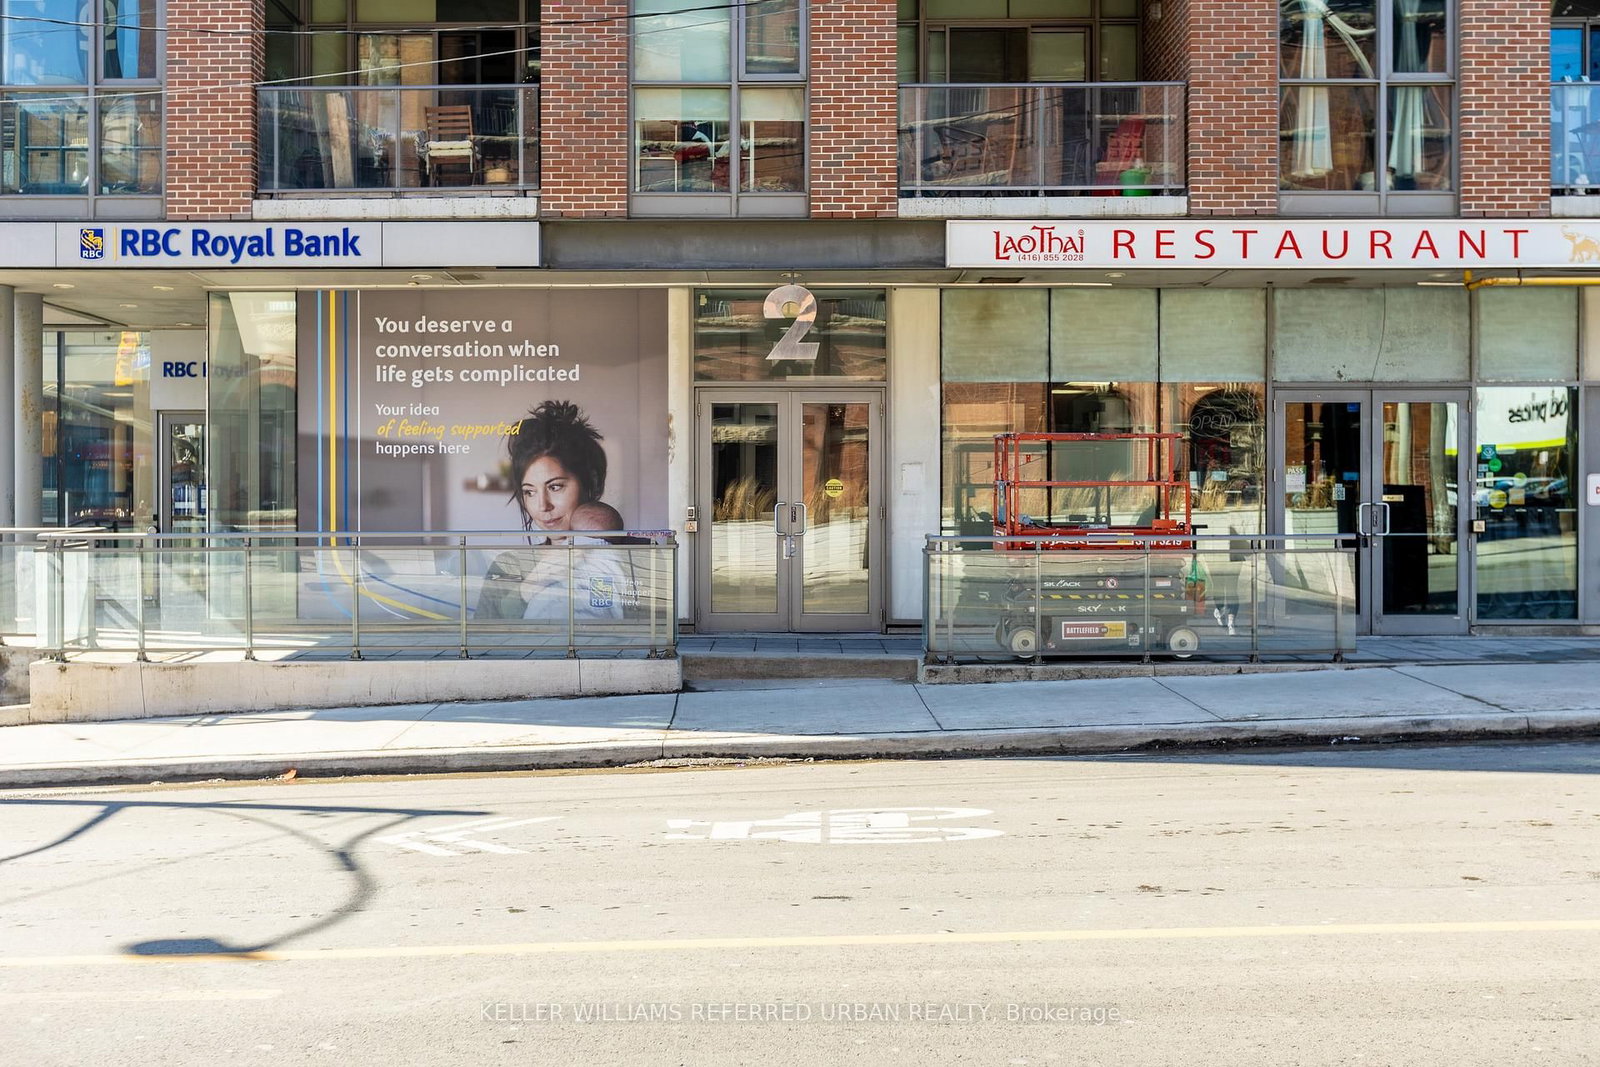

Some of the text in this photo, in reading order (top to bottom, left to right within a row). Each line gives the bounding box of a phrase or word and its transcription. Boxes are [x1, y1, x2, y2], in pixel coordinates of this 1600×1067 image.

[120, 227, 361, 264] RBC Royal Bank
[1113, 229, 1529, 259] RESTAURANT
[82, 250, 102, 259] RBC
[1018, 254, 1041, 262] (416)
[375, 316, 513, 333] You deserve a
[763, 284, 820, 360] 2
[375, 340, 560, 358] conversation when
[163, 361, 198, 378] RBC
[202, 361, 249, 381] oyal
[375, 364, 580, 388] life gets complicated
[375, 403, 440, 416] Your idea
[377, 419, 523, 441] of feeling supported
[1191, 415, 1232, 430] OPEN
[375, 441, 470, 457] happens here
[1077, 604, 1126, 613] SKYK
